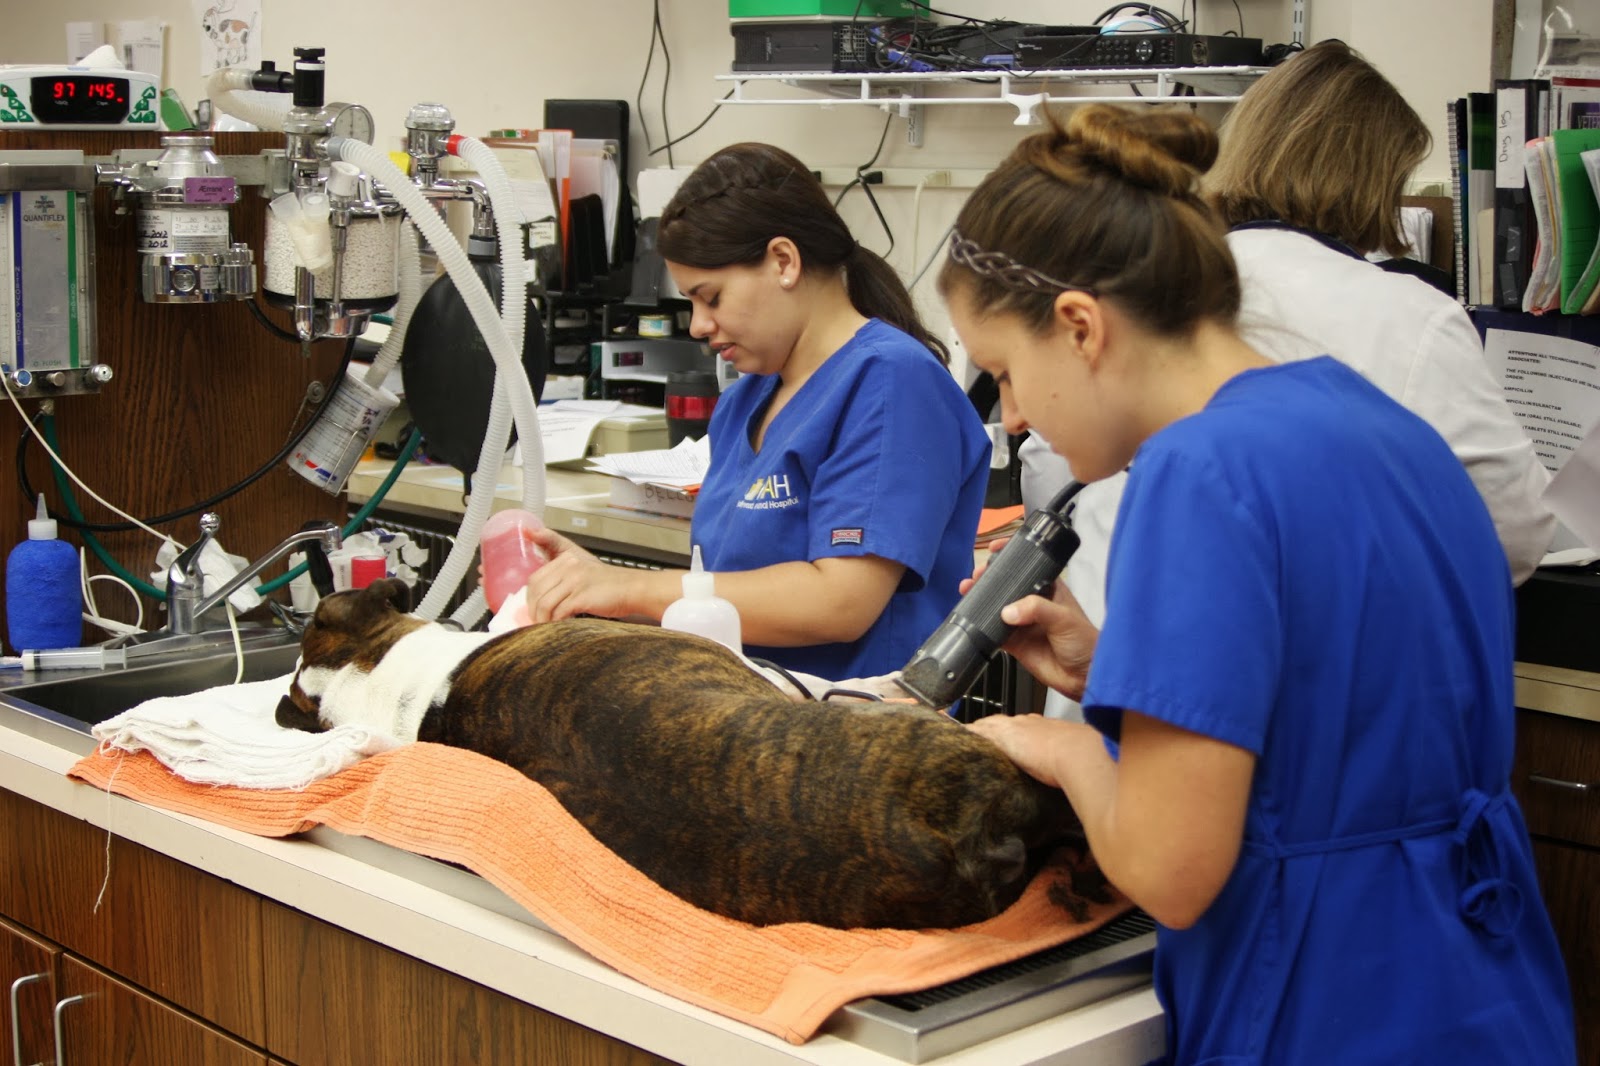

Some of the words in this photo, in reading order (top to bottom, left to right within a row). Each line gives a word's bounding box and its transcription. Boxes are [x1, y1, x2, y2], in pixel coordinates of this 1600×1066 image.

[53, 82, 75, 98] 97
[88, 83, 115, 99] 145
[23, 214, 65, 222] QUANTIFLEX
[1517, 369, 1547, 378] FOLLOWING
[1506, 398, 1562, 411] MPICILLIN/SULBACTAM
